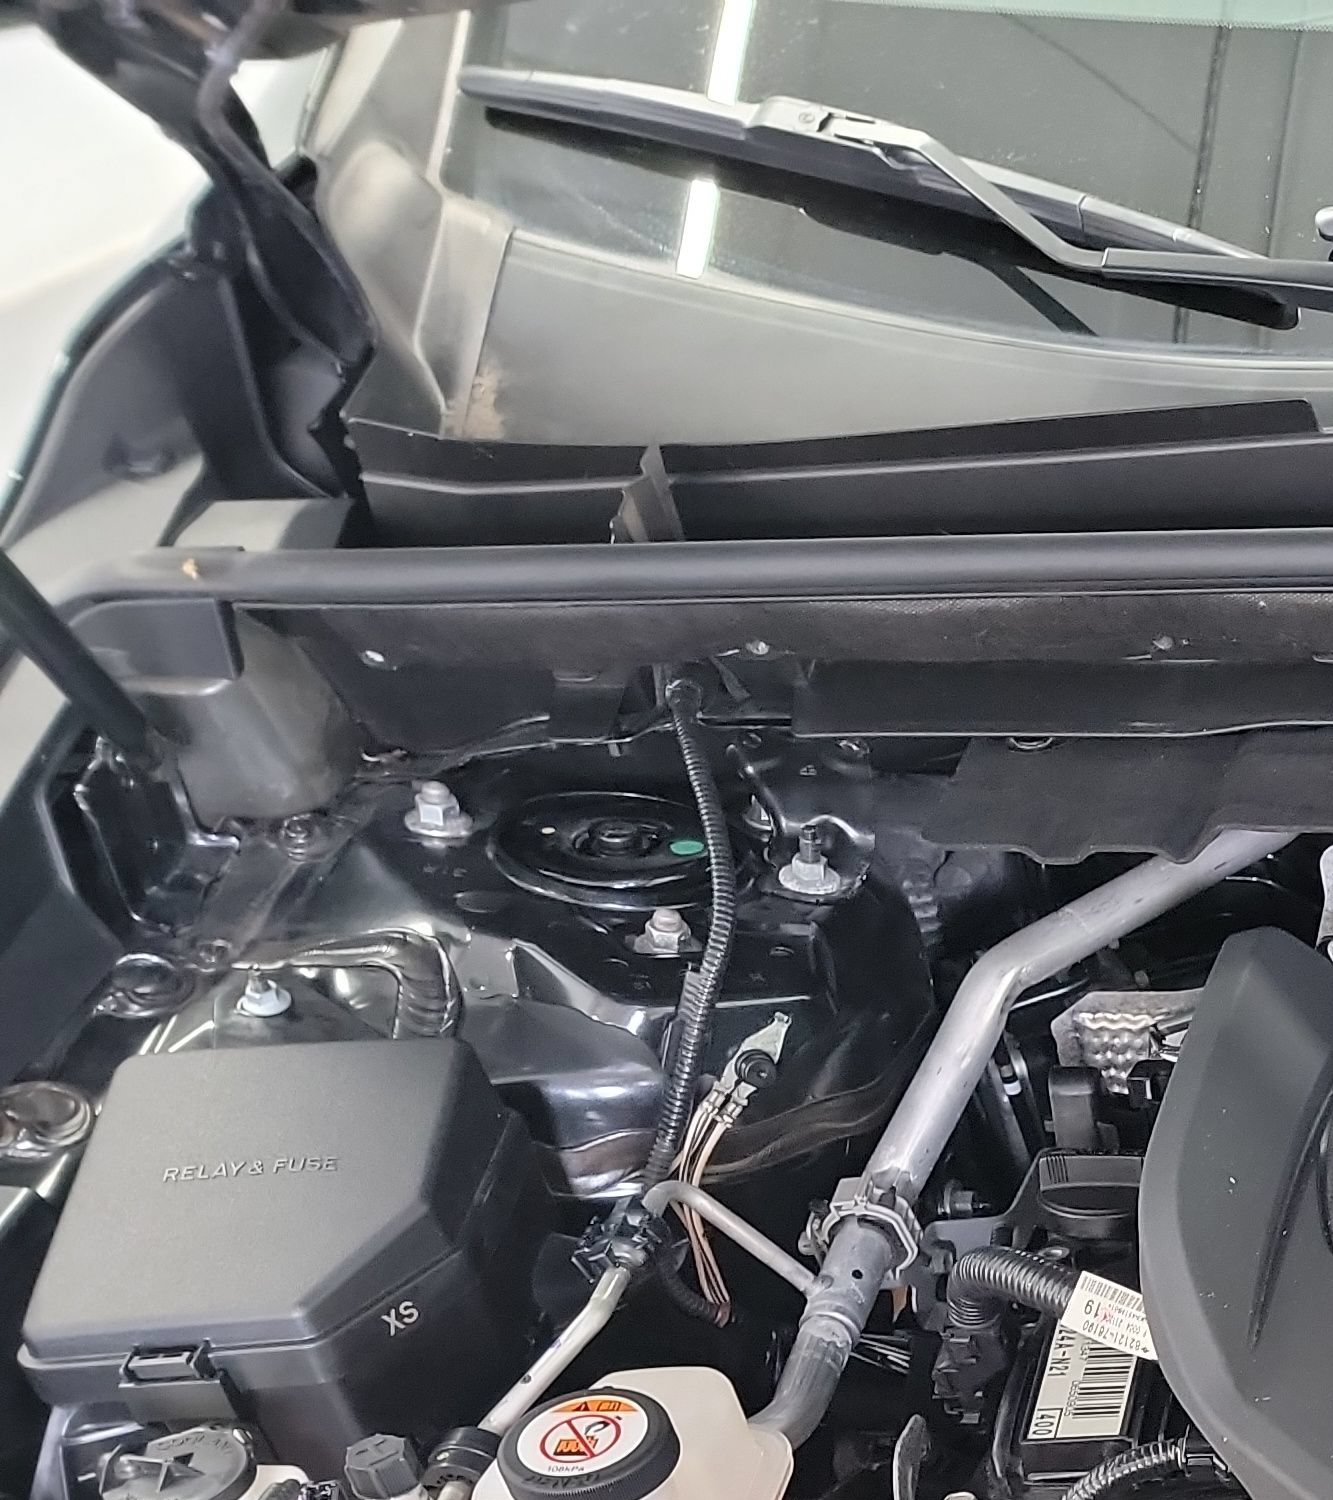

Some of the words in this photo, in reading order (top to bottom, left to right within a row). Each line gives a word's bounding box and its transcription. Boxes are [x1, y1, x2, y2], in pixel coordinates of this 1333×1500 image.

[162, 1160, 247, 1183] RELAY
[249, 1159, 264, 1176] &
[273, 1156, 340, 1174] FUSE
[381, 1301, 419, 1337] XS
[1084, 1300, 1101, 1319] 19
[1047, 1324, 1077, 1377] 24A-N21
[1032, 1414, 1056, 1436] 400
